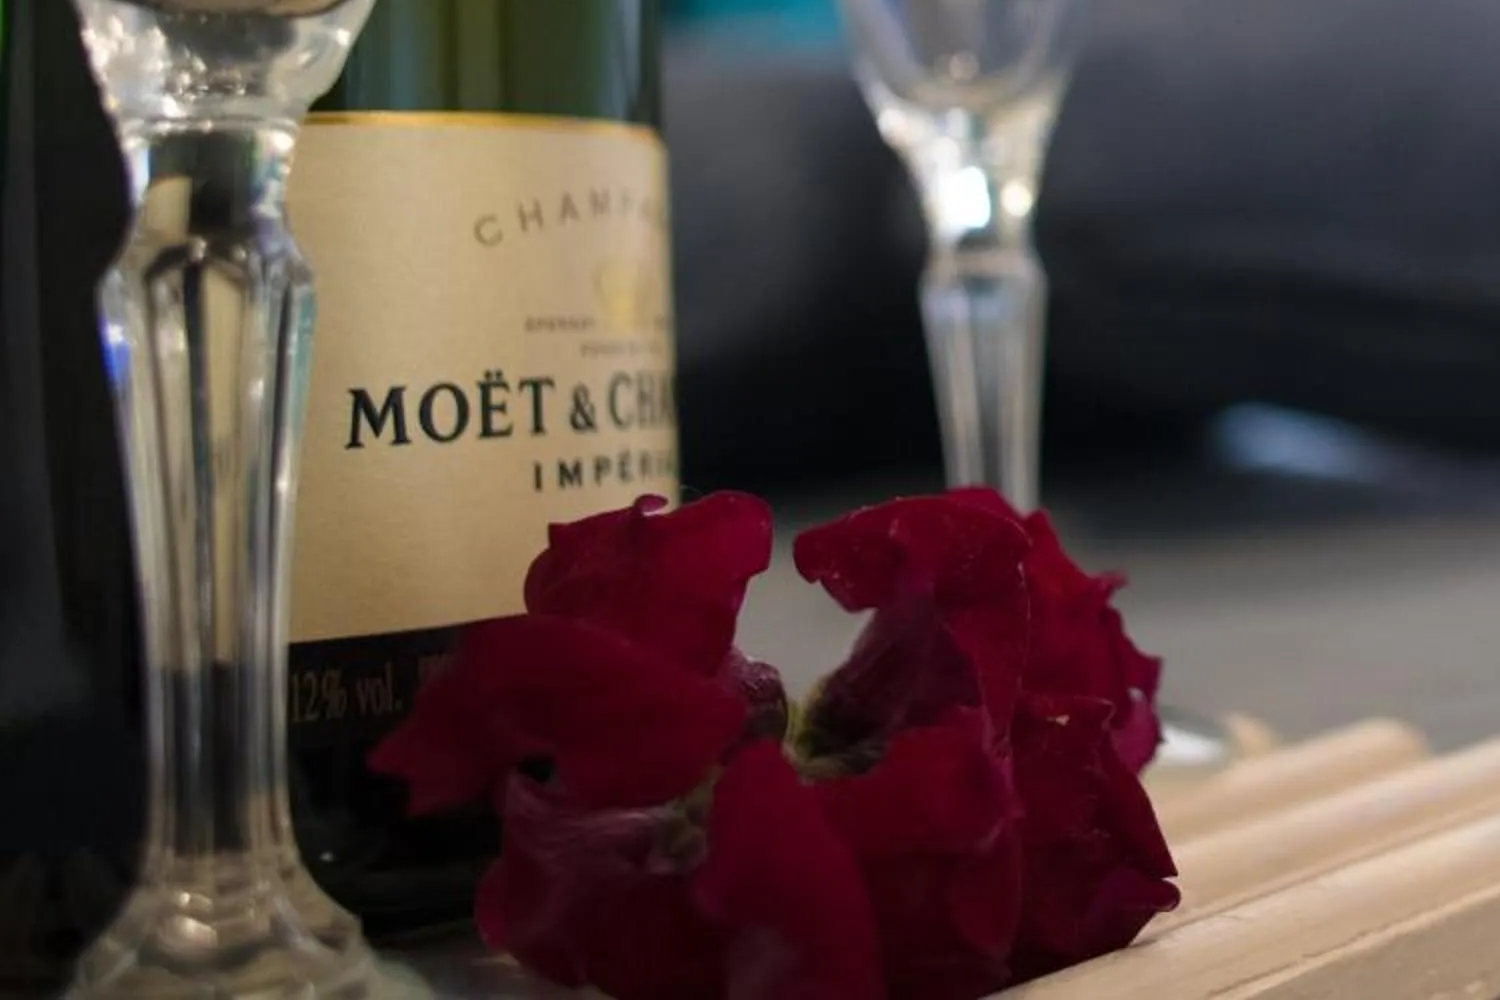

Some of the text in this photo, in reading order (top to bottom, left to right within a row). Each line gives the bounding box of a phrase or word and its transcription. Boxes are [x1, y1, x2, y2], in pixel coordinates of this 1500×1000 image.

[344, 369, 556, 450] MOËT
[569, 382, 598, 434] &
[291, 666, 348, 724] 12%
[355, 661, 403, 717] vol.
